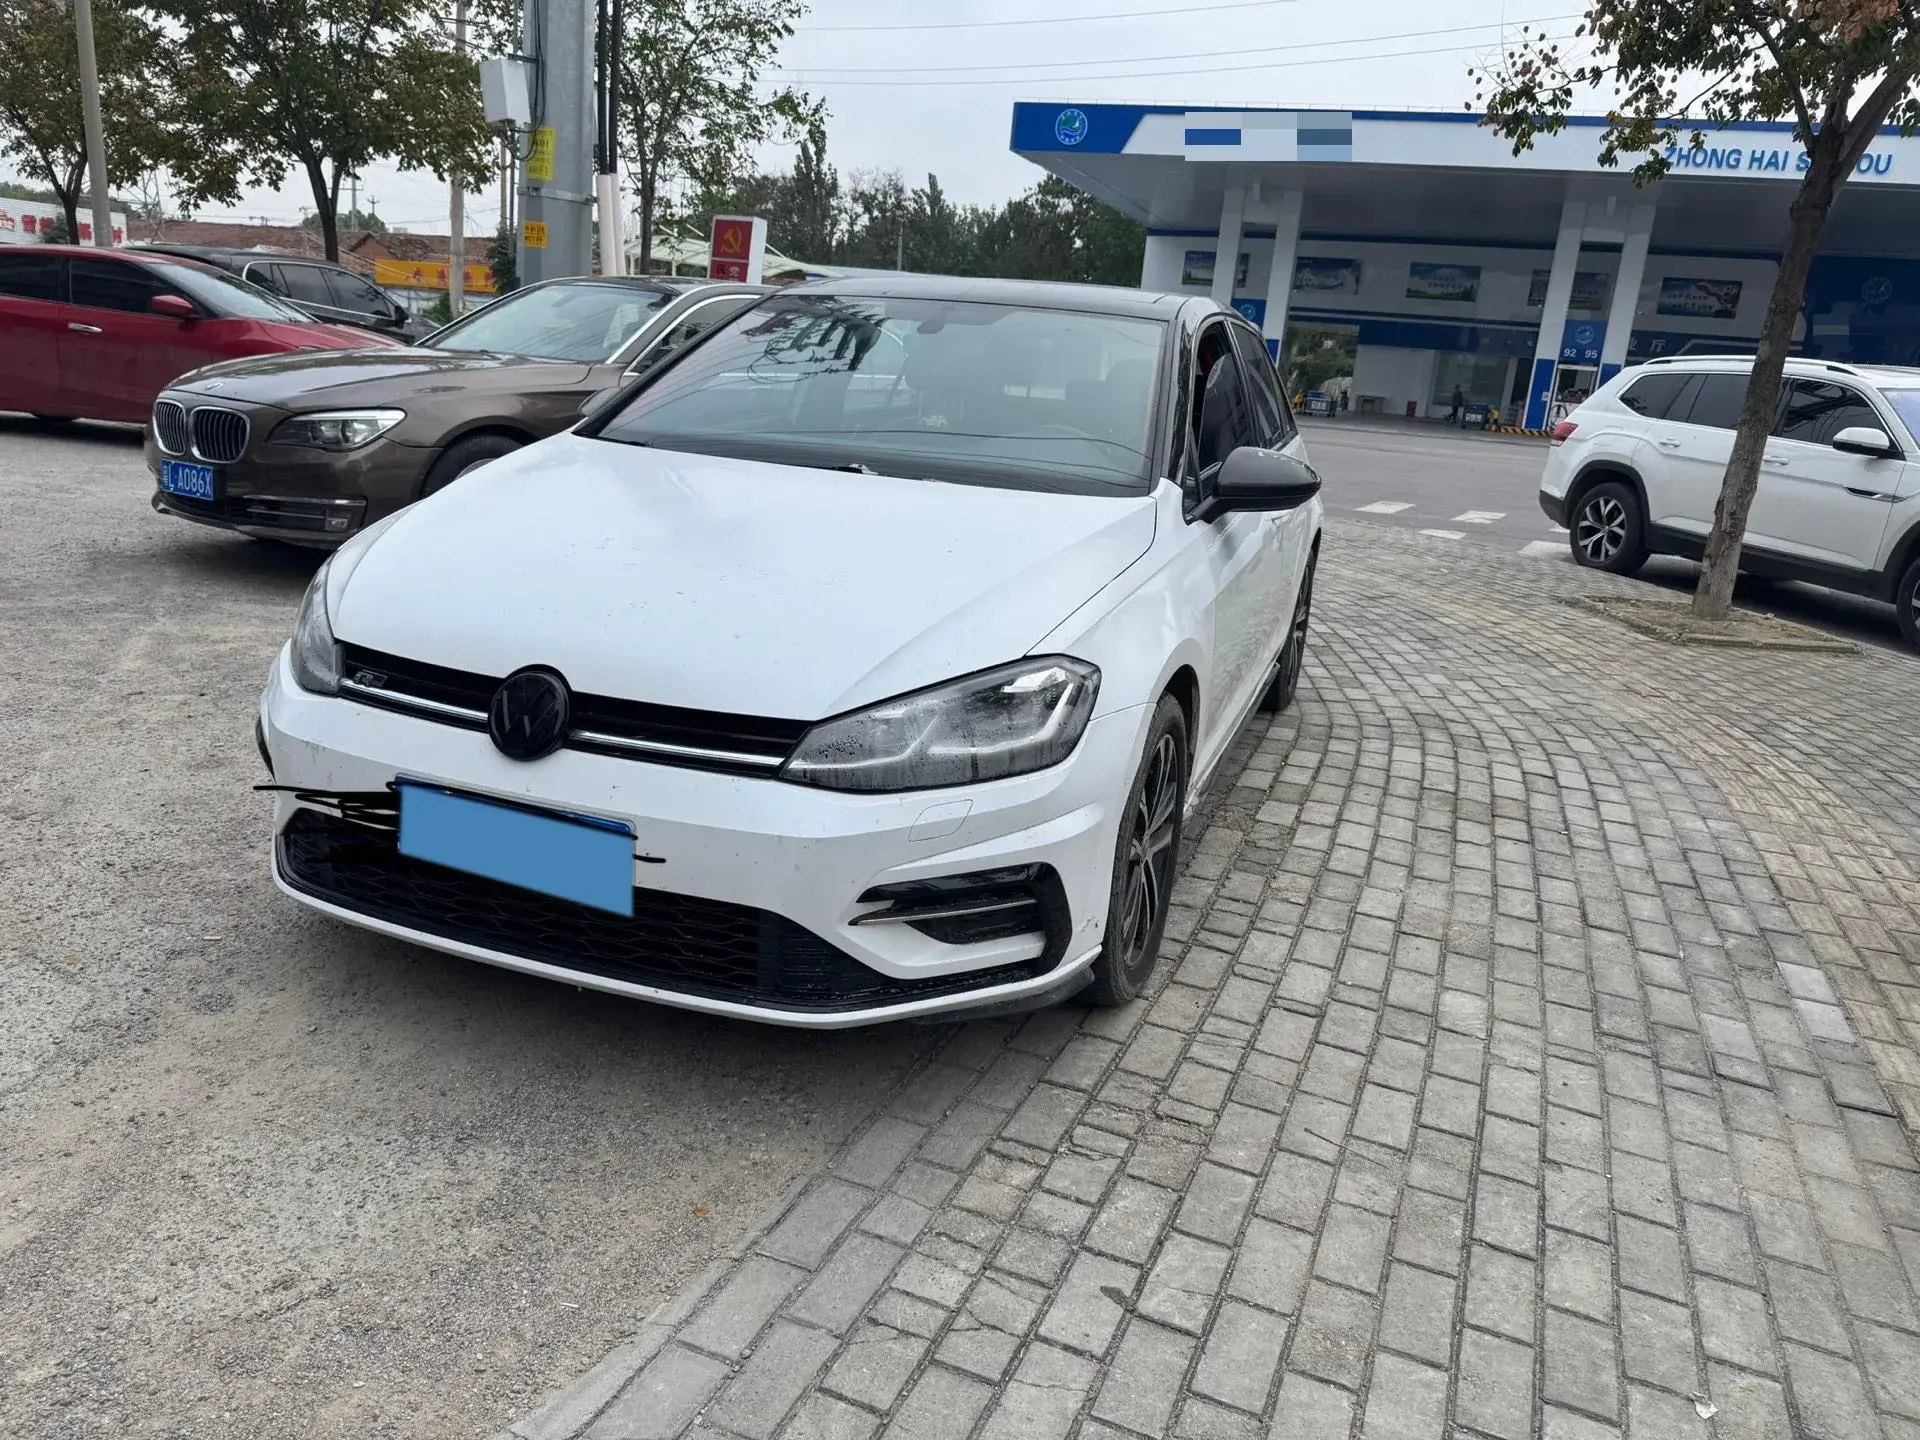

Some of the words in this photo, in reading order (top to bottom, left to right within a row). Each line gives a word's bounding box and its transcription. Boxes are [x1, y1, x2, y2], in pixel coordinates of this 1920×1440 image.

[1665, 147, 1742, 170] ZHONG
[1748, 149, 1789, 172] HAI
[1563, 347, 1577, 358] 92
[1584, 349, 1598, 359] 95
